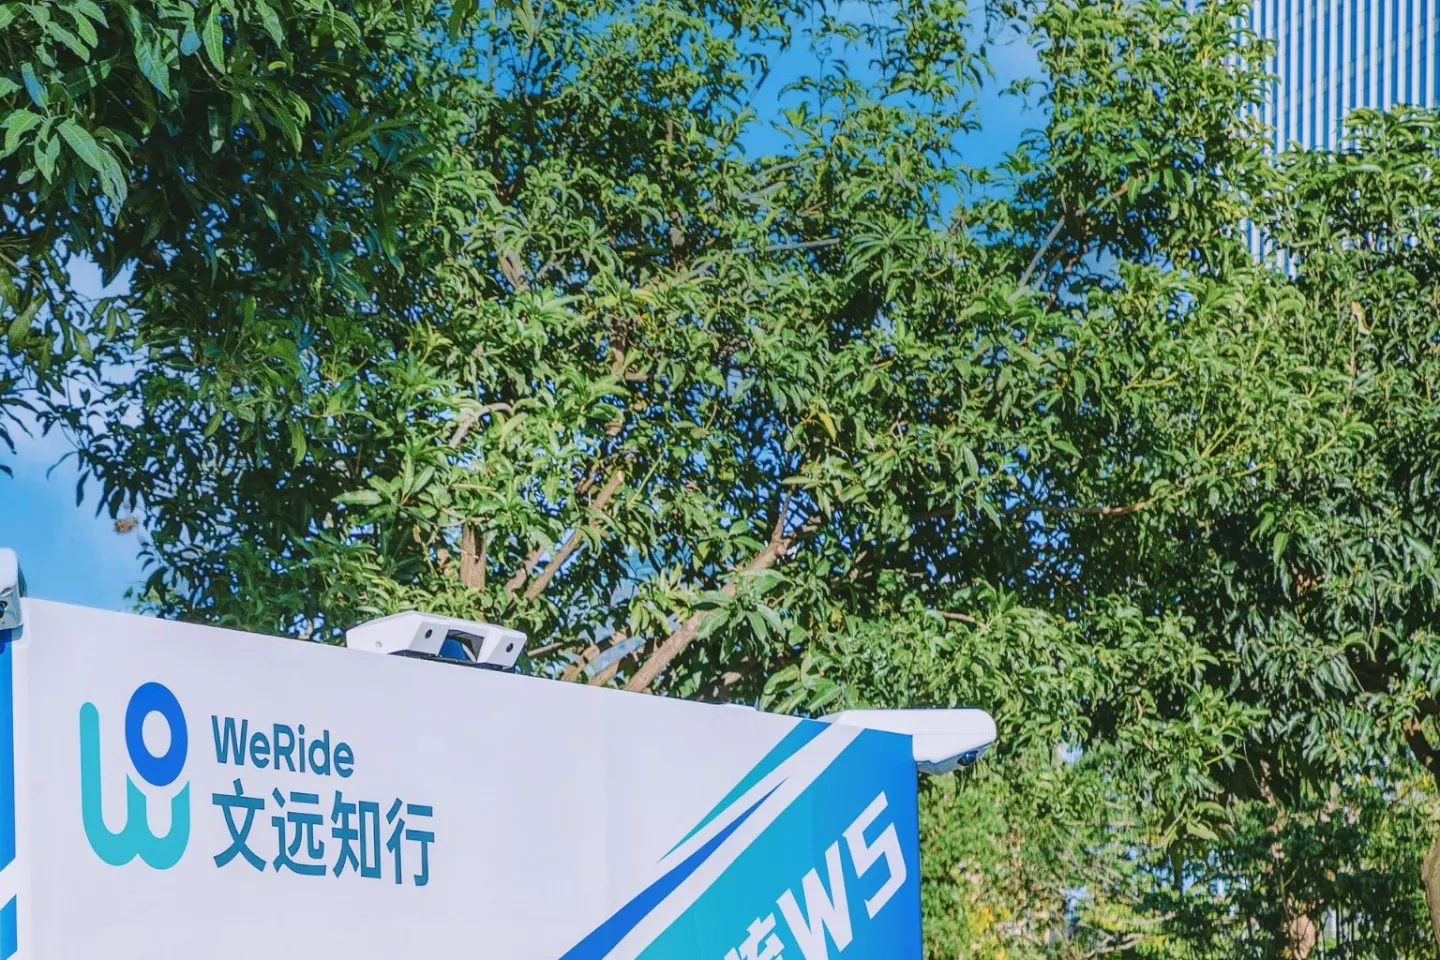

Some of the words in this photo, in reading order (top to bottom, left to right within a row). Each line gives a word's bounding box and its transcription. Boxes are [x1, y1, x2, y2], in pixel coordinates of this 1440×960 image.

[211, 715, 356, 778] WeRide
[211, 778, 436, 887] 文远知行
